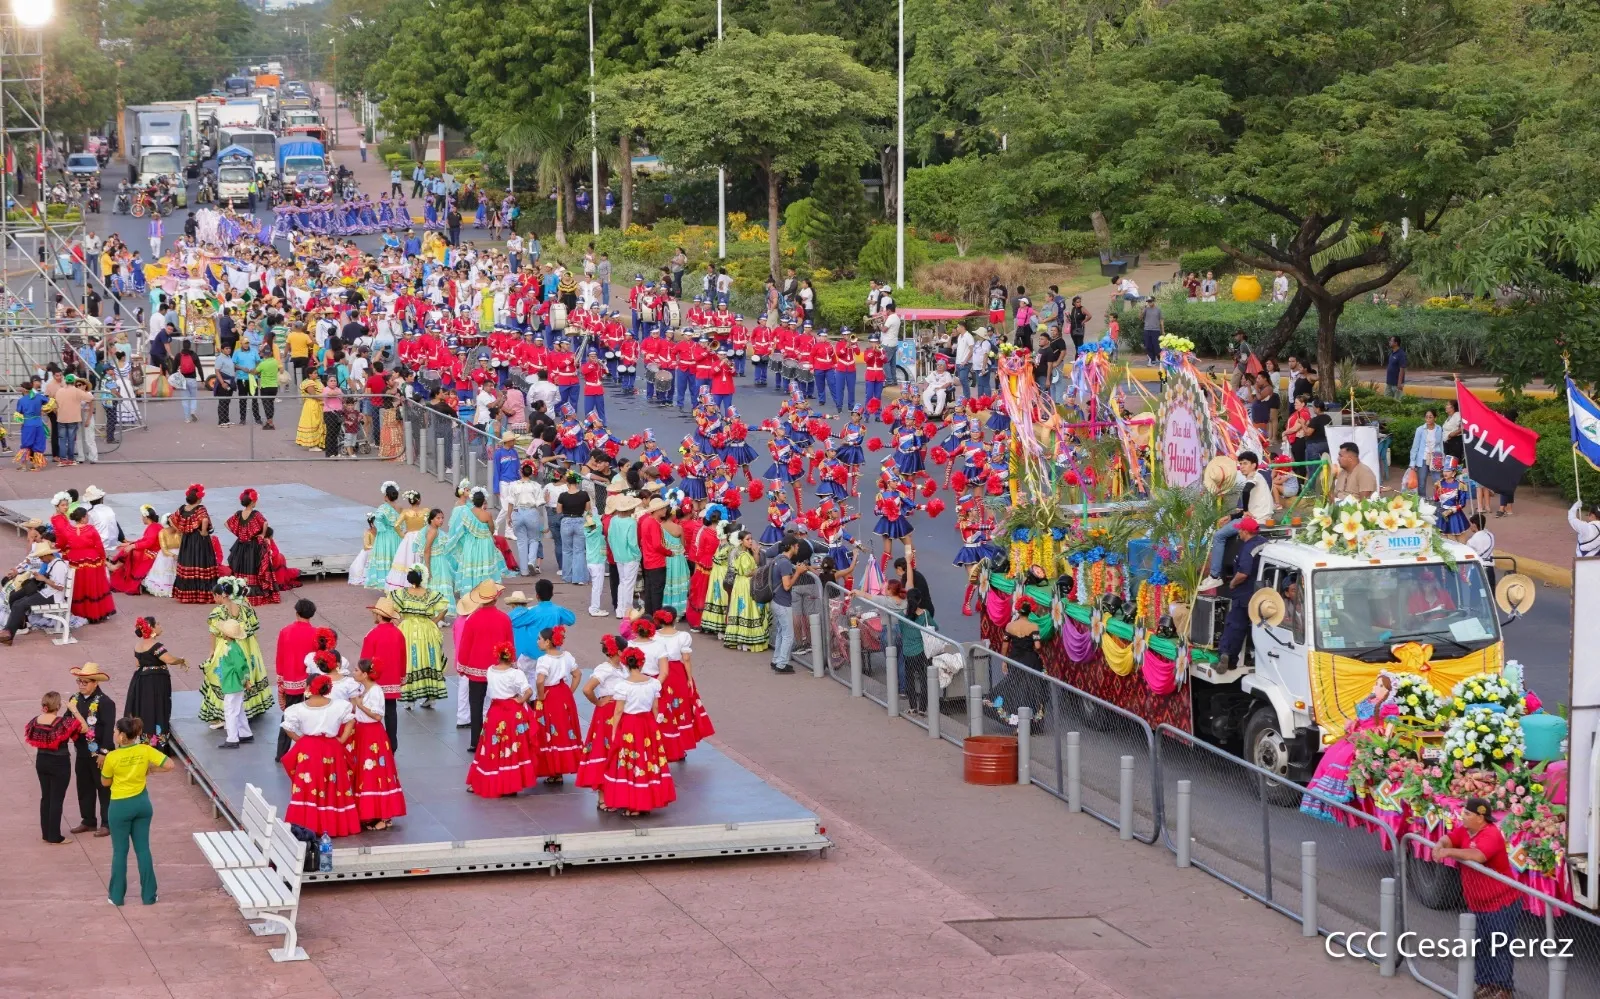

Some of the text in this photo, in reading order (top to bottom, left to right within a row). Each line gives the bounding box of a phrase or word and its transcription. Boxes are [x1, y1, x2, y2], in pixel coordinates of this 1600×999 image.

[1183, 421, 1191, 438] del
[1462, 418, 1515, 463] SLN
[1168, 442, 1197, 482] Huipil
[1388, 536, 1421, 547] MINED
